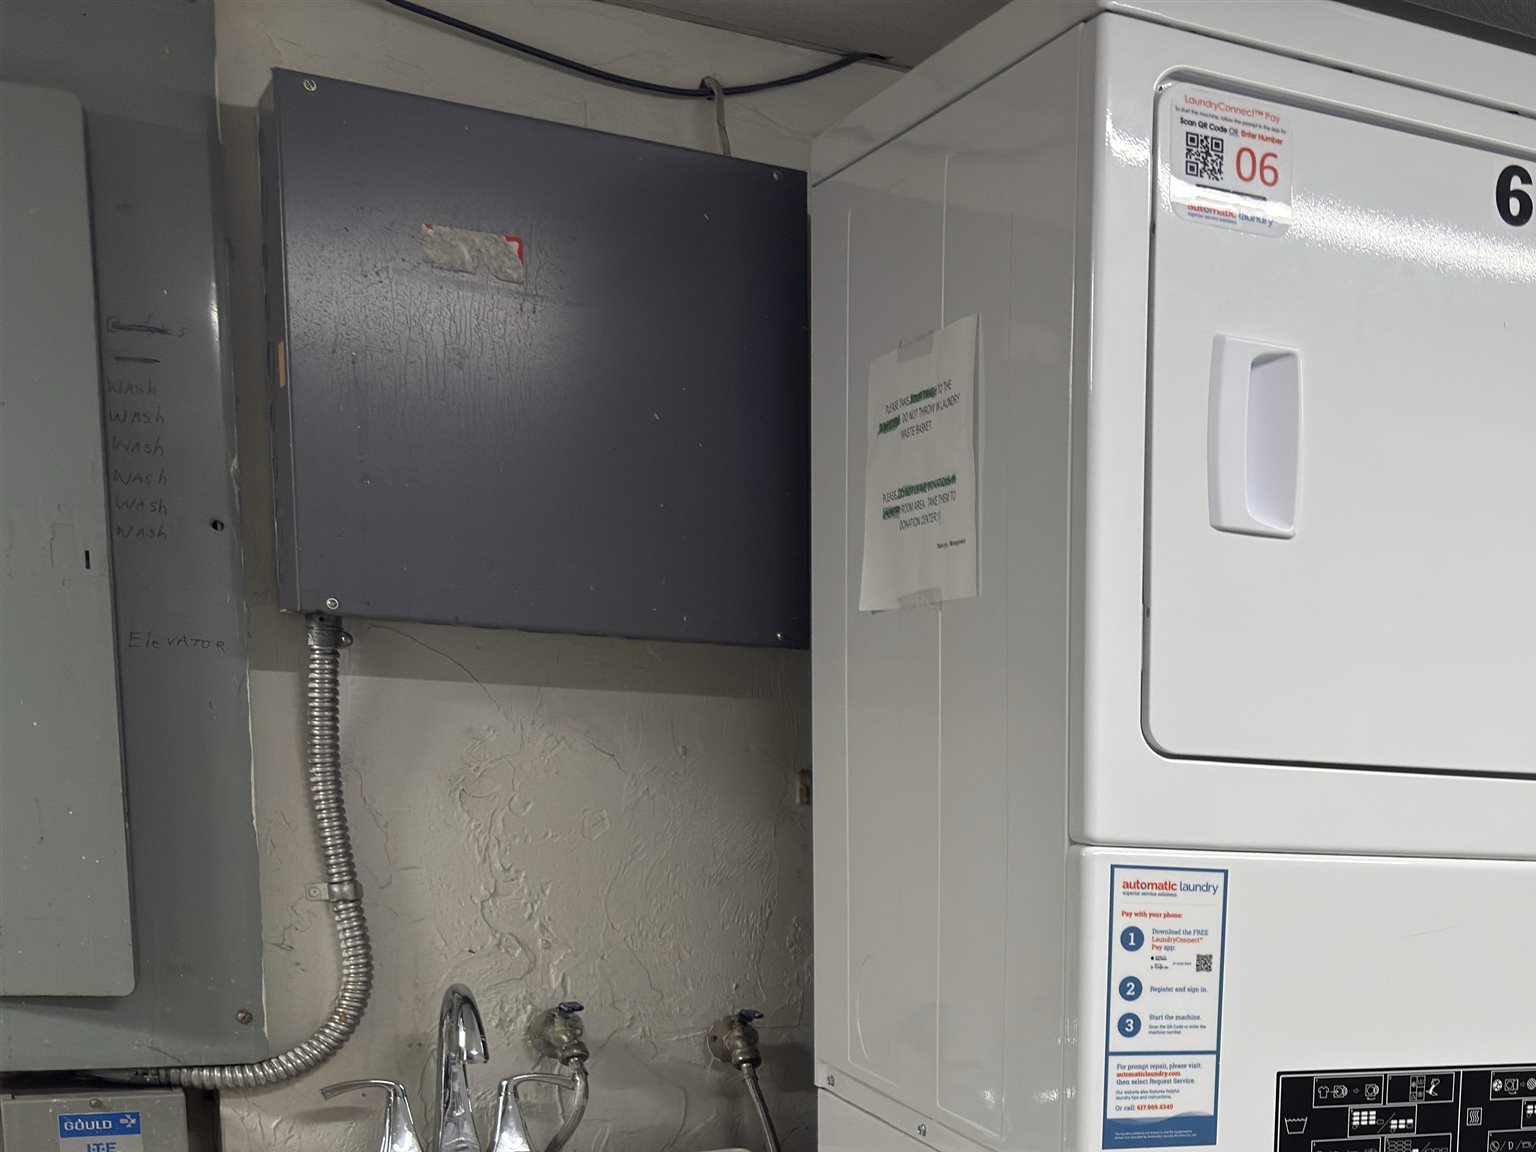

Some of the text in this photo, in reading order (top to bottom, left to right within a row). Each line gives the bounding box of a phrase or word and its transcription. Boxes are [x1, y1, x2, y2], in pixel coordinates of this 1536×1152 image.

[1265, 112, 1281, 124] Pay
[1180, 117, 1197, 127] Scan
[1198, 121, 1208, 129] QR
[1209, 123, 1227, 133] Code
[1241, 130, 1256, 139] Enter
[1258, 135, 1283, 145] Number
[1236, 147, 1279, 187] 06
[1496, 165, 1533, 226] 6
[1122, 879, 1218, 895] automatic laundry
[1129, 933, 1136, 946] 1
[1126, 982, 1135, 996] 2
[1125, 1019, 1134, 1032] 3
[1169, 1062, 1187, 1070] please
[64, 1119, 113, 1131] GOULD
